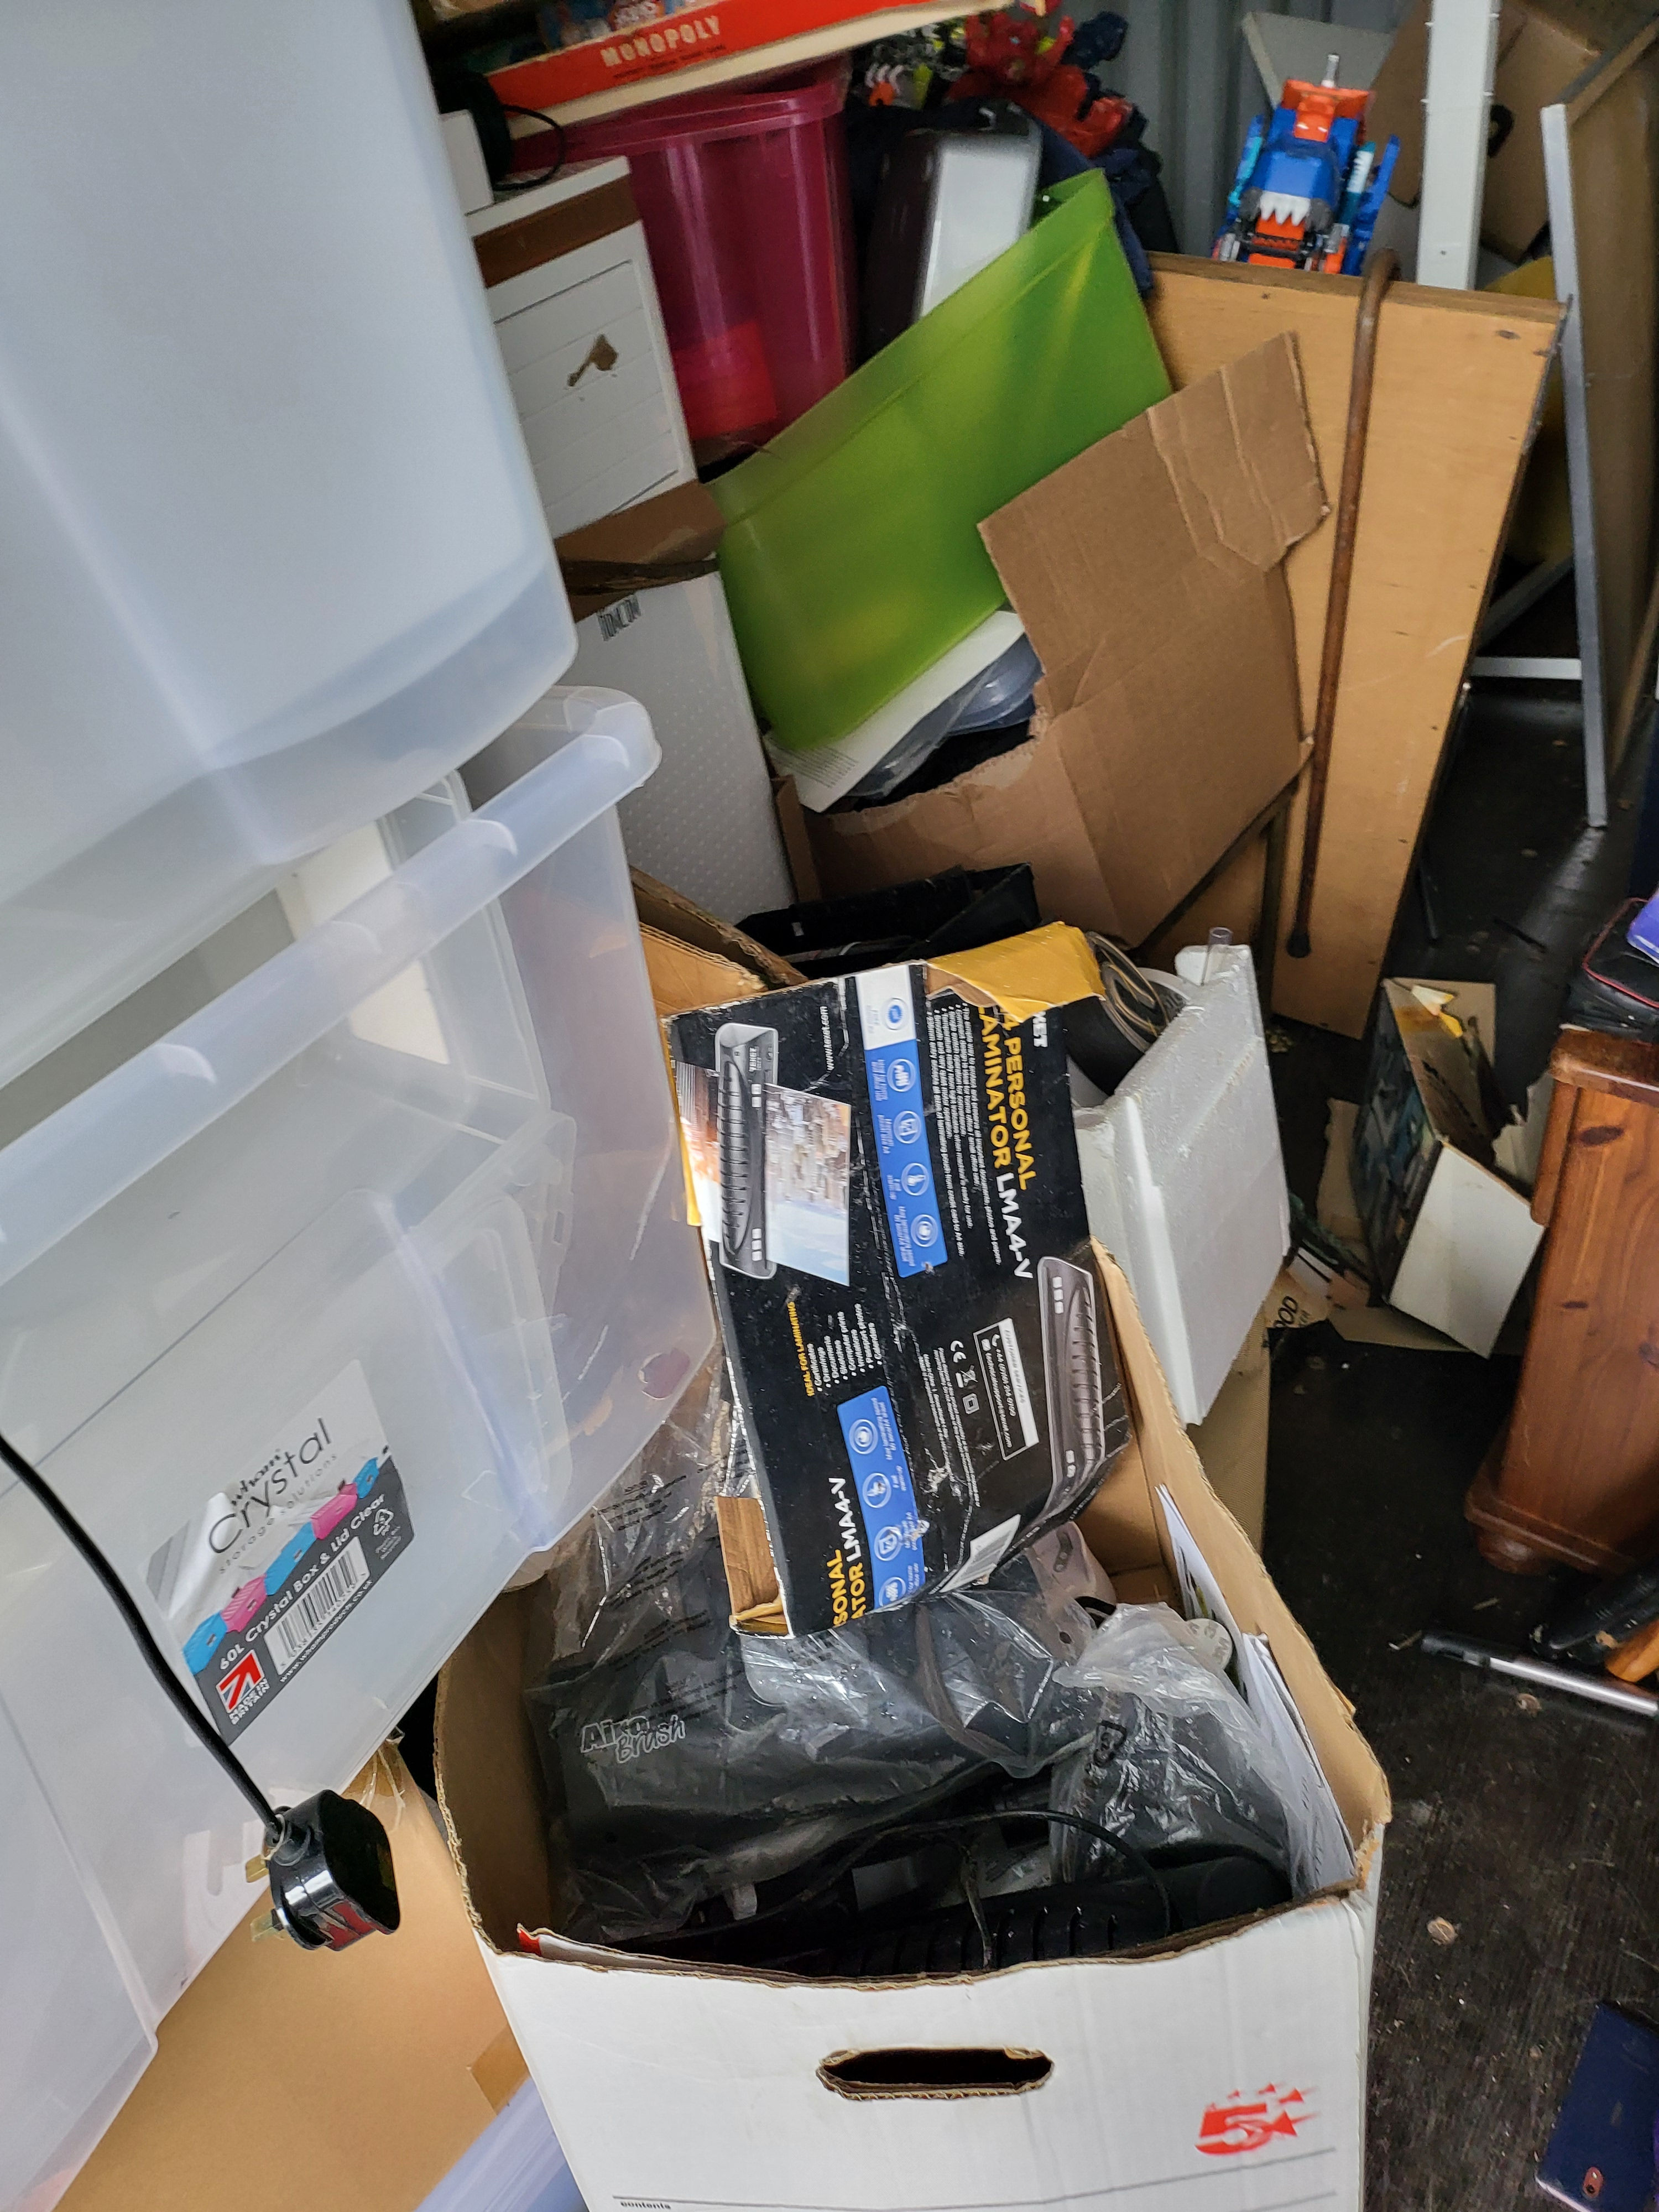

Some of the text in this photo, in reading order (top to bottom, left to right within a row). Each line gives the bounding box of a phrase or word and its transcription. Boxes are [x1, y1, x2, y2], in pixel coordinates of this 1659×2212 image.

[599, 14, 720, 67] MONOPOLY
[962, 1008, 971, 1021] The
[963, 1021, 973, 1042] simple
[818, 1005, 835, 1071] www.texet.com
[959, 1039, 967, 1062] design
[966, 1042, 974, 1056] way
[963, 1095, 972, 1114] home
[969, 1089, 978, 1101] and
[1004, 1037, 1036, 1190] PERSONAL
[965, 1114, 973, 1131] office
[984, 1206, 994, 1228] photos
[989, 1228, 998, 1241] and
[995, 1172, 1033, 1278] LMA4-V
[787, 1301, 815, 1396] IDEAL FOR LAMINATING
[837, 1311, 857, 1371] Computer prints
[851, 1329, 866, 1367] Invitations
[854, 1303, 874, 1364] Passport photos
[807, 1343, 822, 1386] Certificates
[817, 1347, 831, 1382] Drawings
[824, 1335, 839, 1378] Documents
[834, 1340, 848, 1375] Sketches
[207, 1417, 331, 1552] Crystal
[231, 1454, 281, 1506] wham
[828, 1478, 862, 1562] LMA4-V
[220, 1641, 245, 1670] 60L
[247, 1589, 293, 1644] Crystal
[293, 1564, 319, 1593] Box
[331, 1527, 349, 1551] Lid
[351, 1493, 386, 1531] Clear
[231, 1682, 270, 1725] BRITAIN
[615, 1714, 685, 1763] Brush
